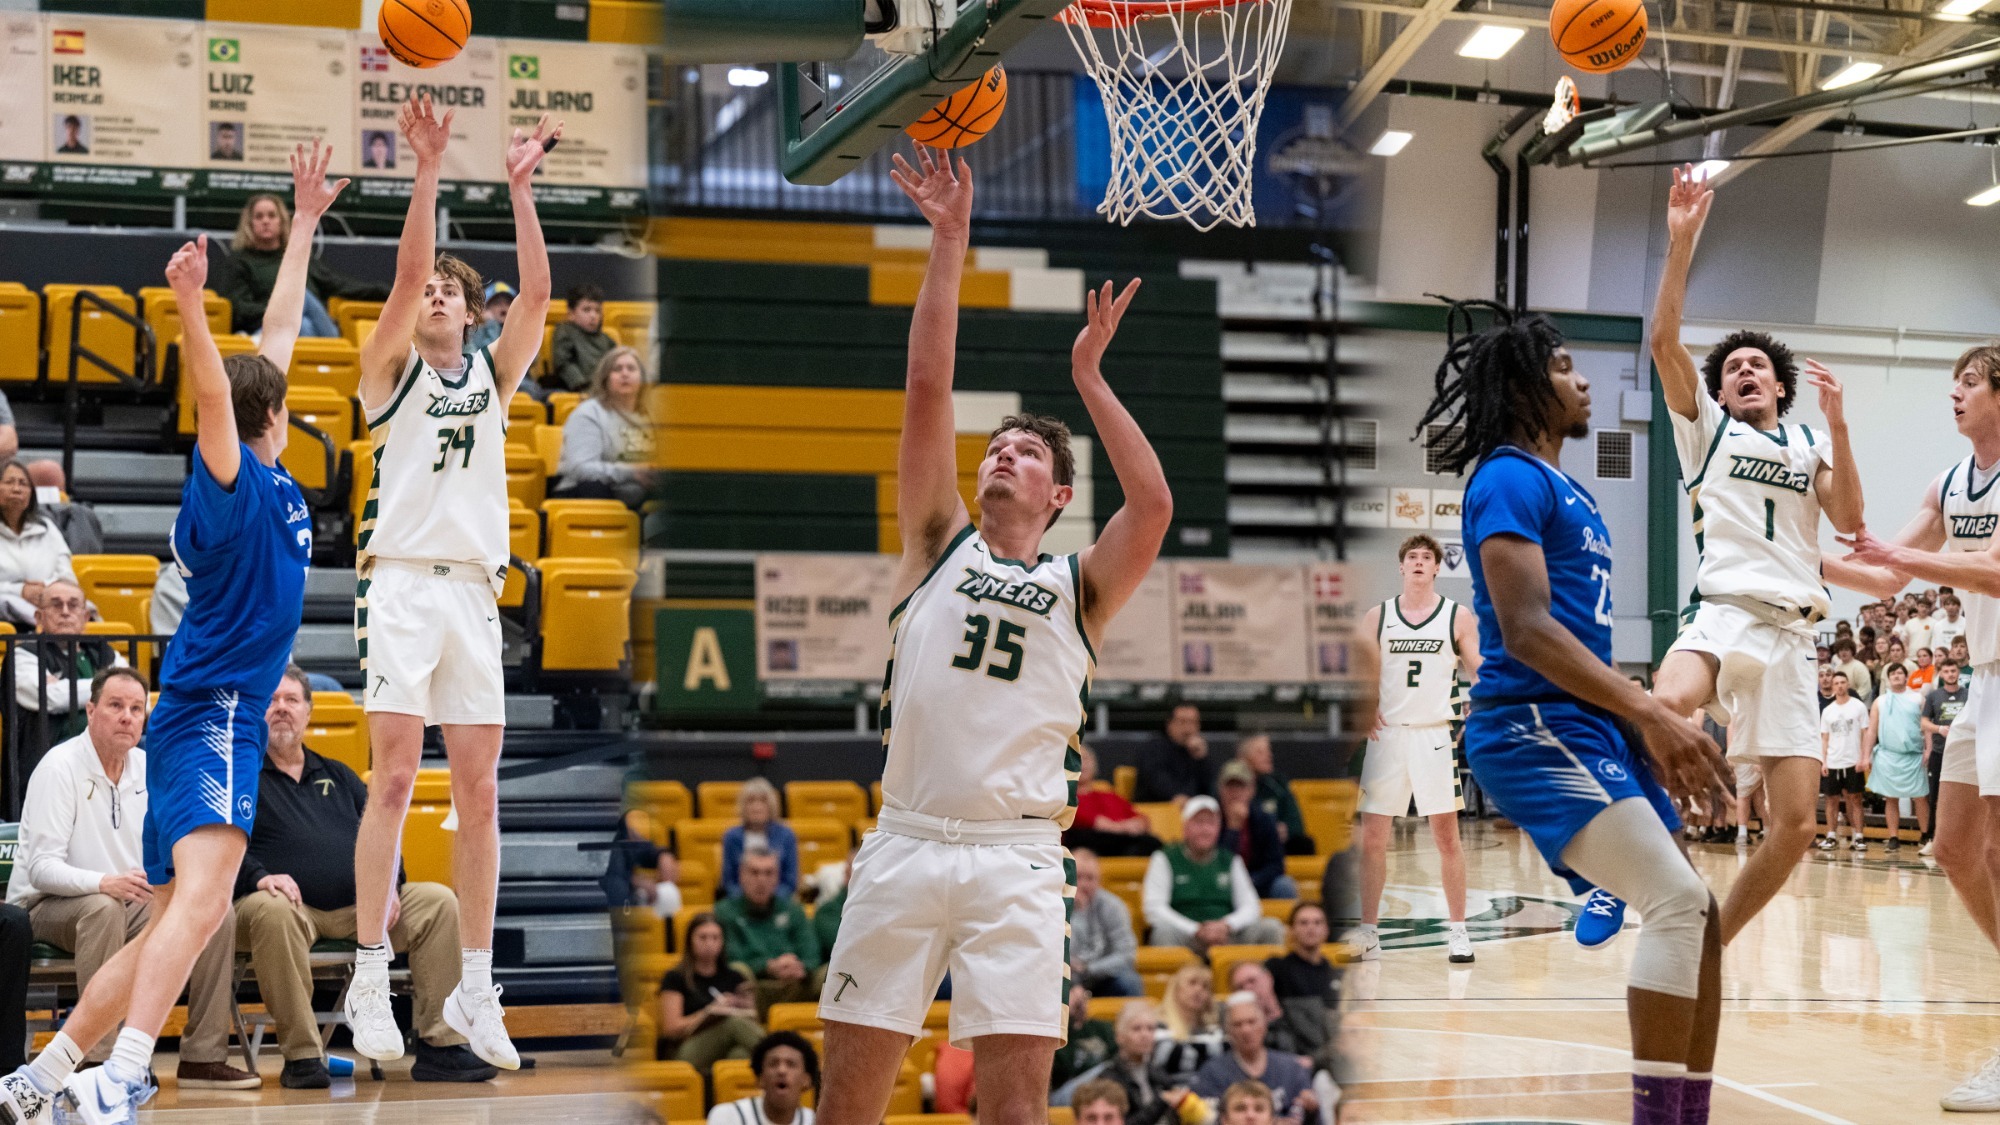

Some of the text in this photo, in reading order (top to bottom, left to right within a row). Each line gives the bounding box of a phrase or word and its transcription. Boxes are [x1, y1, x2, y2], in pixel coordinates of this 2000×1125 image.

[1588, 26, 1644, 66] Wilson
[53, 64, 101, 87] IKER
[208, 73, 253, 94] LUIZ
[361, 82, 485, 107] ALEXANDER
[509, 89, 593, 112] JULIANO
[433, 426, 475, 472] 34
[1764, 497, 1775, 541] 1
[684, 627, 731, 691] A
[952, 612, 1026, 681] 35
[1389, 639, 1443, 653] MINERS
[1407, 661, 1422, 687] 2
